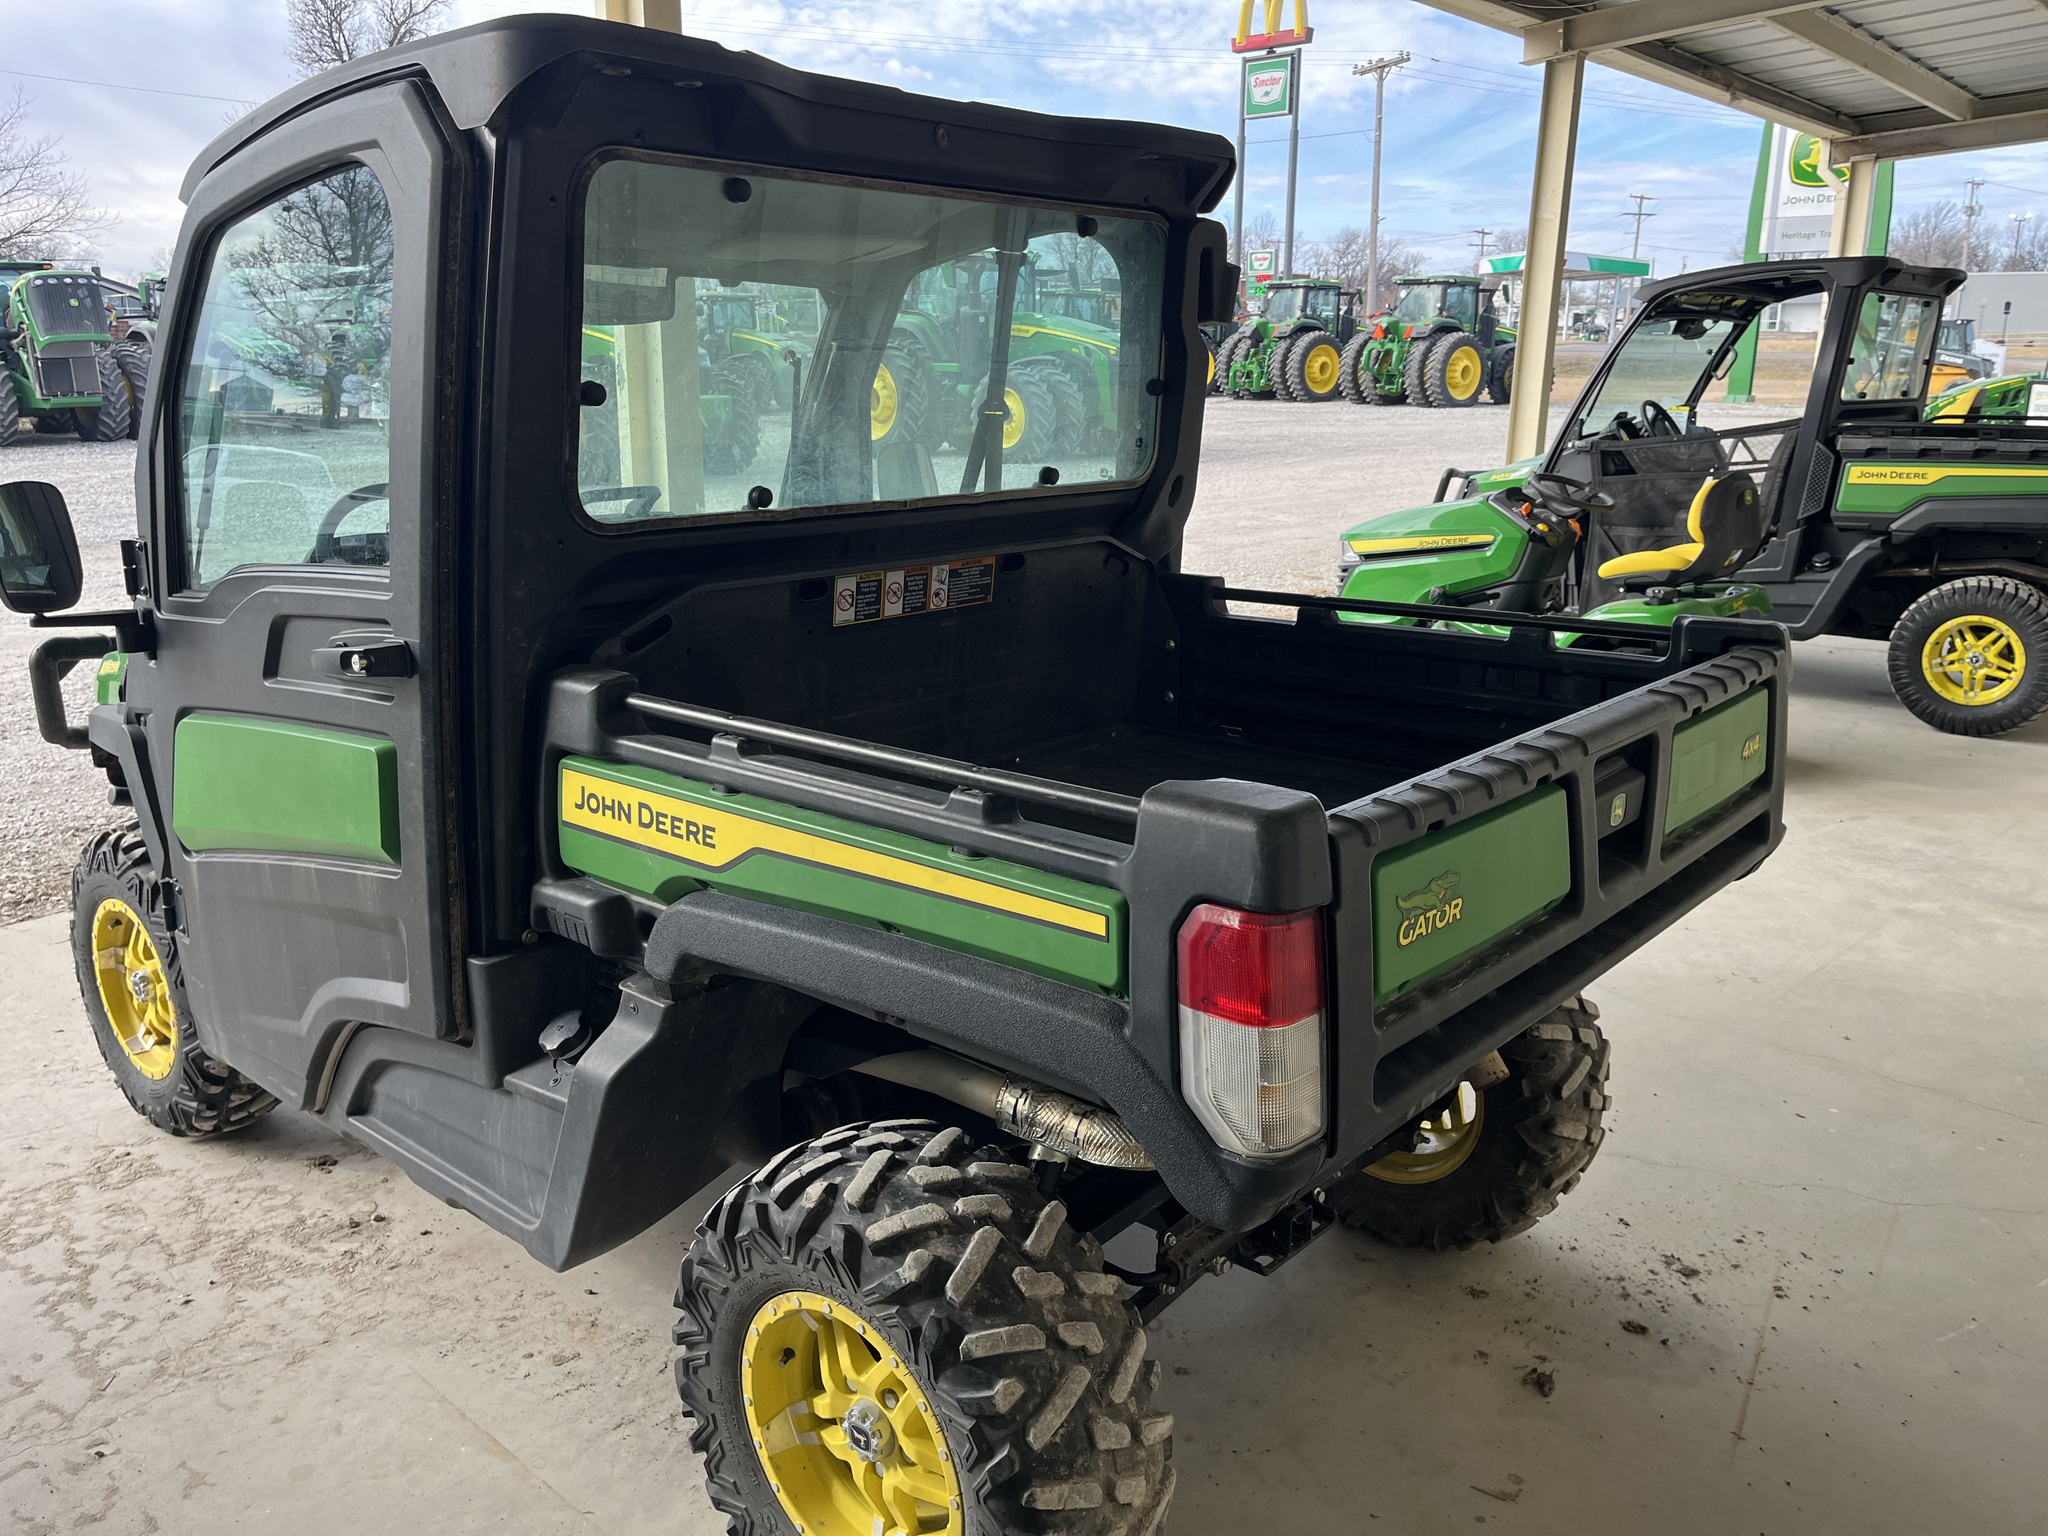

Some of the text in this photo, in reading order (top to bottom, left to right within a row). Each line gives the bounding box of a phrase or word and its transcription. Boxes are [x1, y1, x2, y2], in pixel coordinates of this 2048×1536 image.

[1253, 76, 1282, 88] Sinclair
[1783, 195, 1815, 205] JOHN
[1781, 232, 1816, 240] Heritage
[1857, 471, 1928, 479] JOHN DEERE
[1417, 537, 1470, 548] JOHN DEERE
[575, 786, 716, 849] JOHN DEERE
[1399, 897, 1463, 946] GATOR
